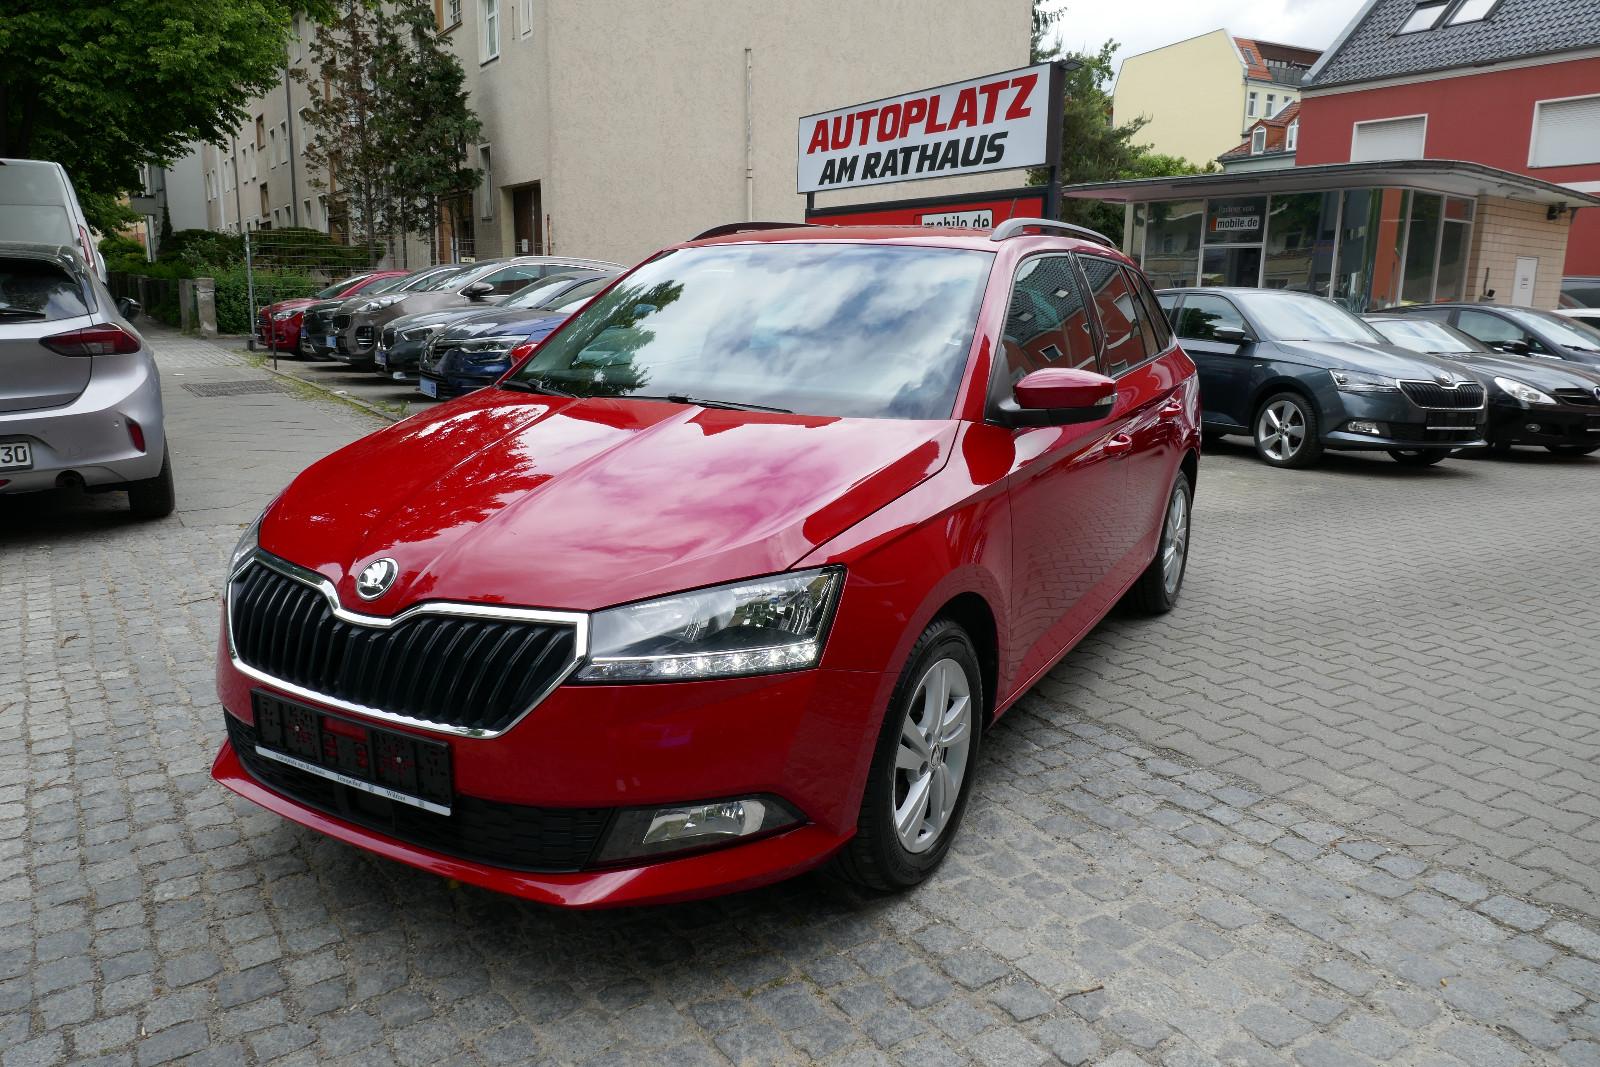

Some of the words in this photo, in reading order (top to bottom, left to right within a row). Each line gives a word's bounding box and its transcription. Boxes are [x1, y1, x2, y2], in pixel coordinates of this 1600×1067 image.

[807, 73, 1039, 154] AUTOPLATZ
[818, 154, 859, 185] AM
[861, 131, 1008, 180] RATHAUS
[1217, 217, 1258, 229] mobile.de
[0, 445, 28, 463] 30
